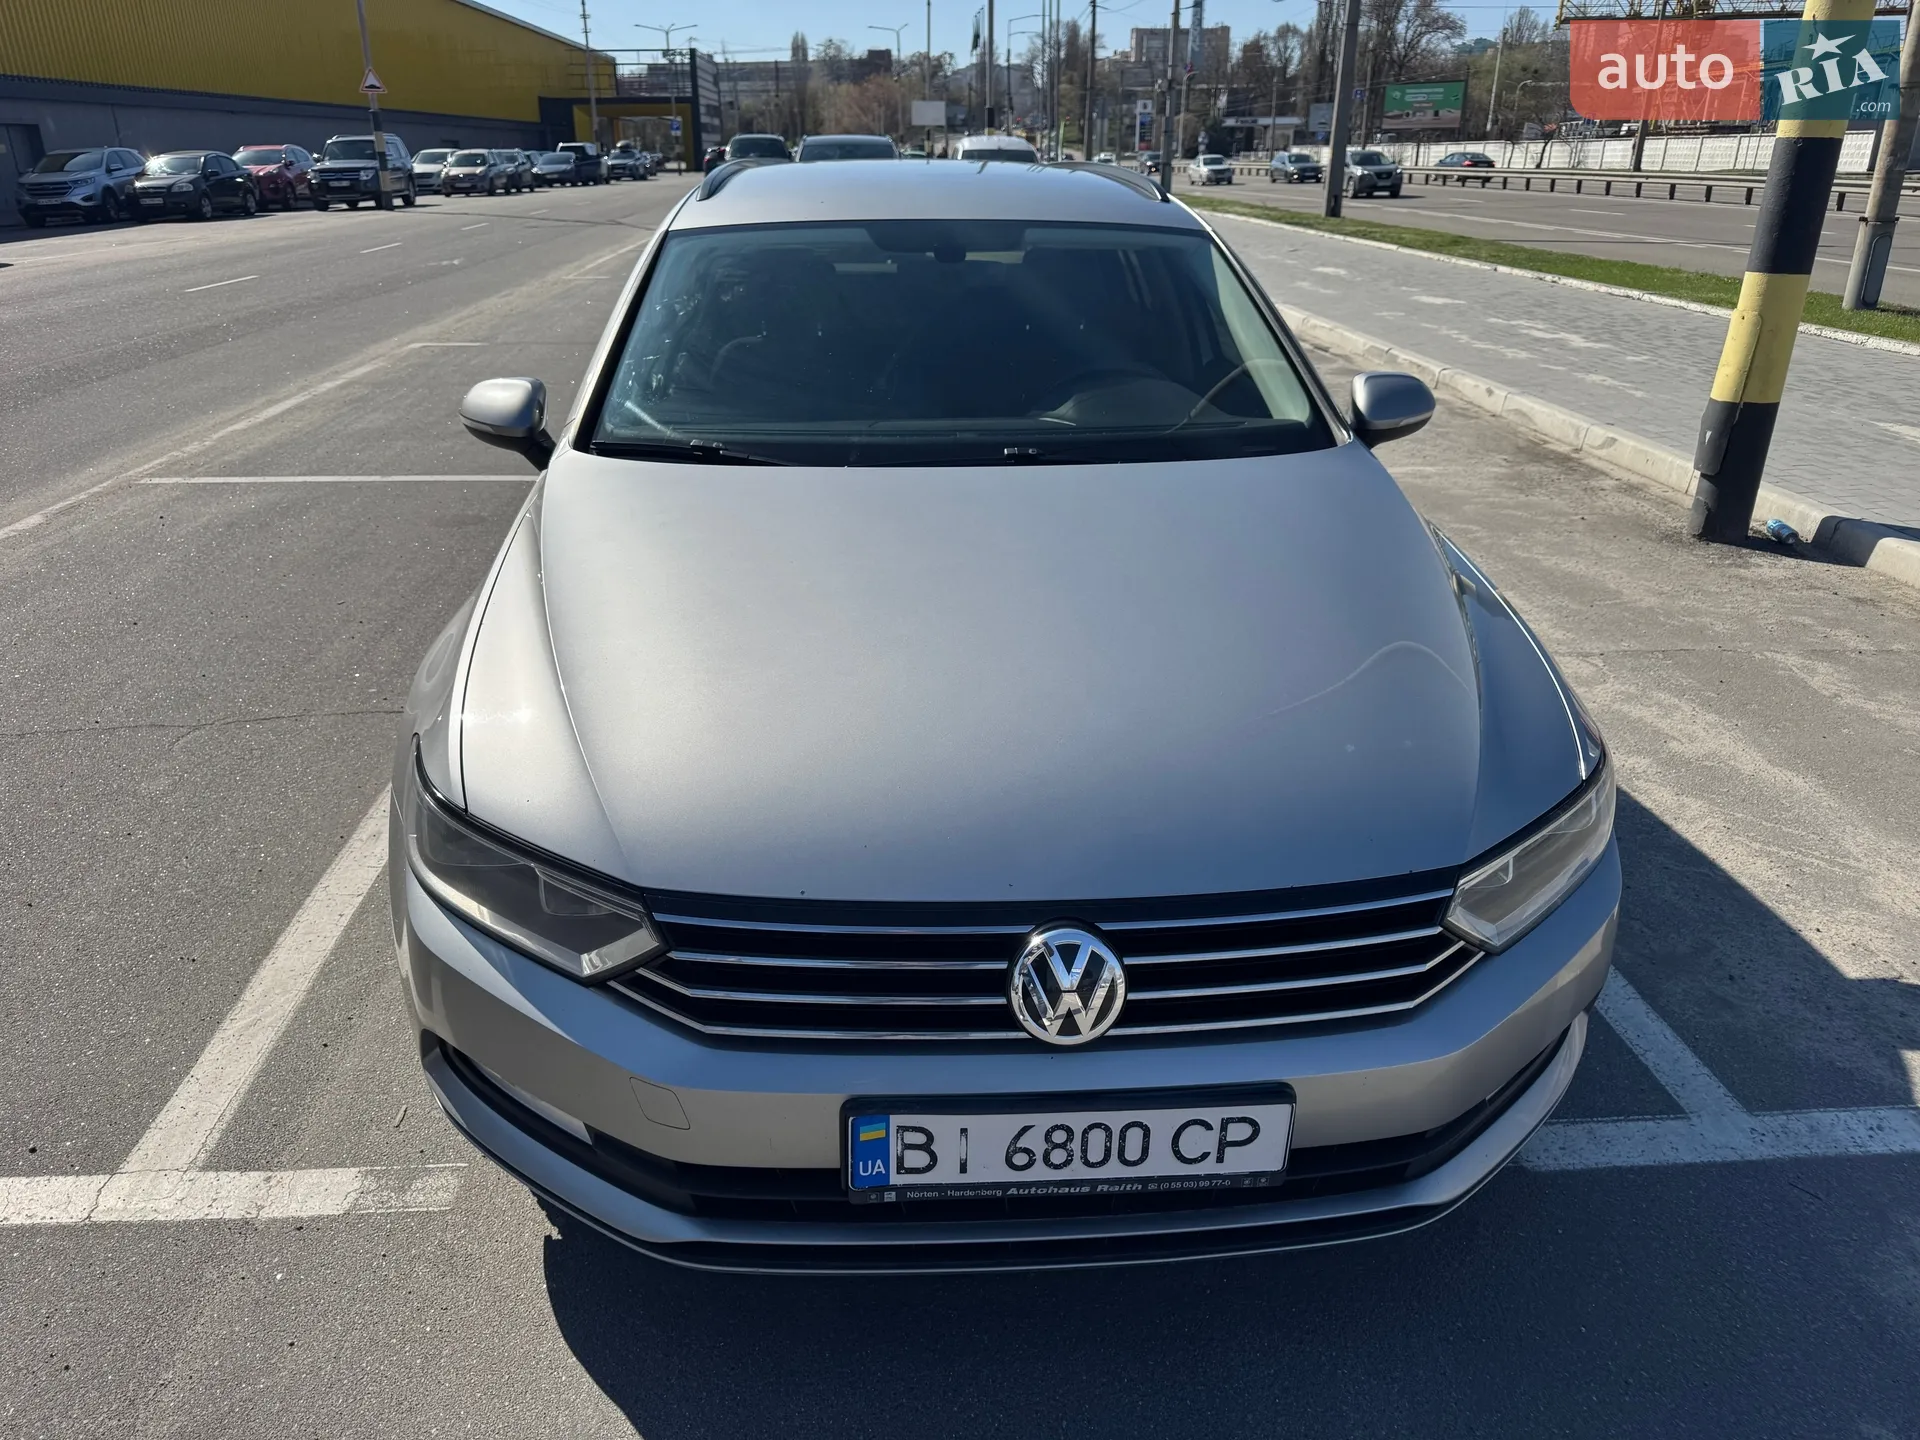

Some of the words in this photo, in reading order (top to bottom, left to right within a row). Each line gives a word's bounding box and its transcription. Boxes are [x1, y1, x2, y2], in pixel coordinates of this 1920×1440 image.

[896, 1125, 969, 1175] BI
[1004, 1120, 1151, 1173] 6800
[1171, 1116, 1261, 1165] CP
[859, 1159, 886, 1176] UA
[947, 1189, 1003, 1199] Hardenberg
[1006, 1186, 1091, 1196] Autohaus
[1096, 1183, 1143, 1193] Raith
